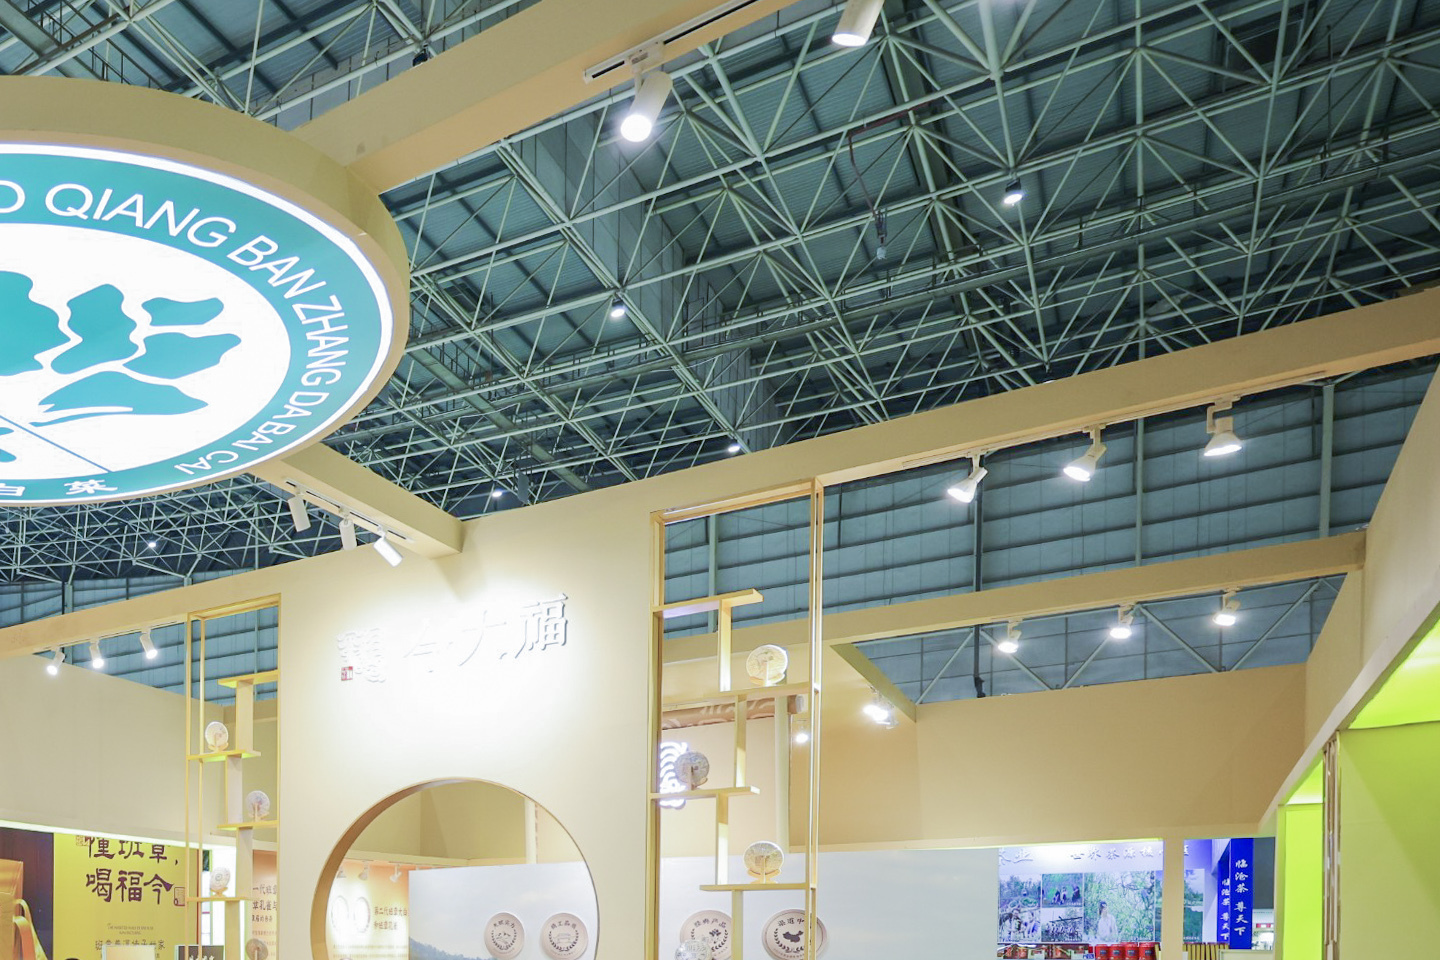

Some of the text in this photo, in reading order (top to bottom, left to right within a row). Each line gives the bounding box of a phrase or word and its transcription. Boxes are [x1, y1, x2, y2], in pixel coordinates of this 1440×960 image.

[45, 183, 237, 248] QIANG
[226, 235, 327, 299] BAN
[292, 294, 349, 386] ZHANG
[272, 391, 330, 419] DA
[231, 421, 297, 451] BAI
[174, 450, 239, 475] CAI
